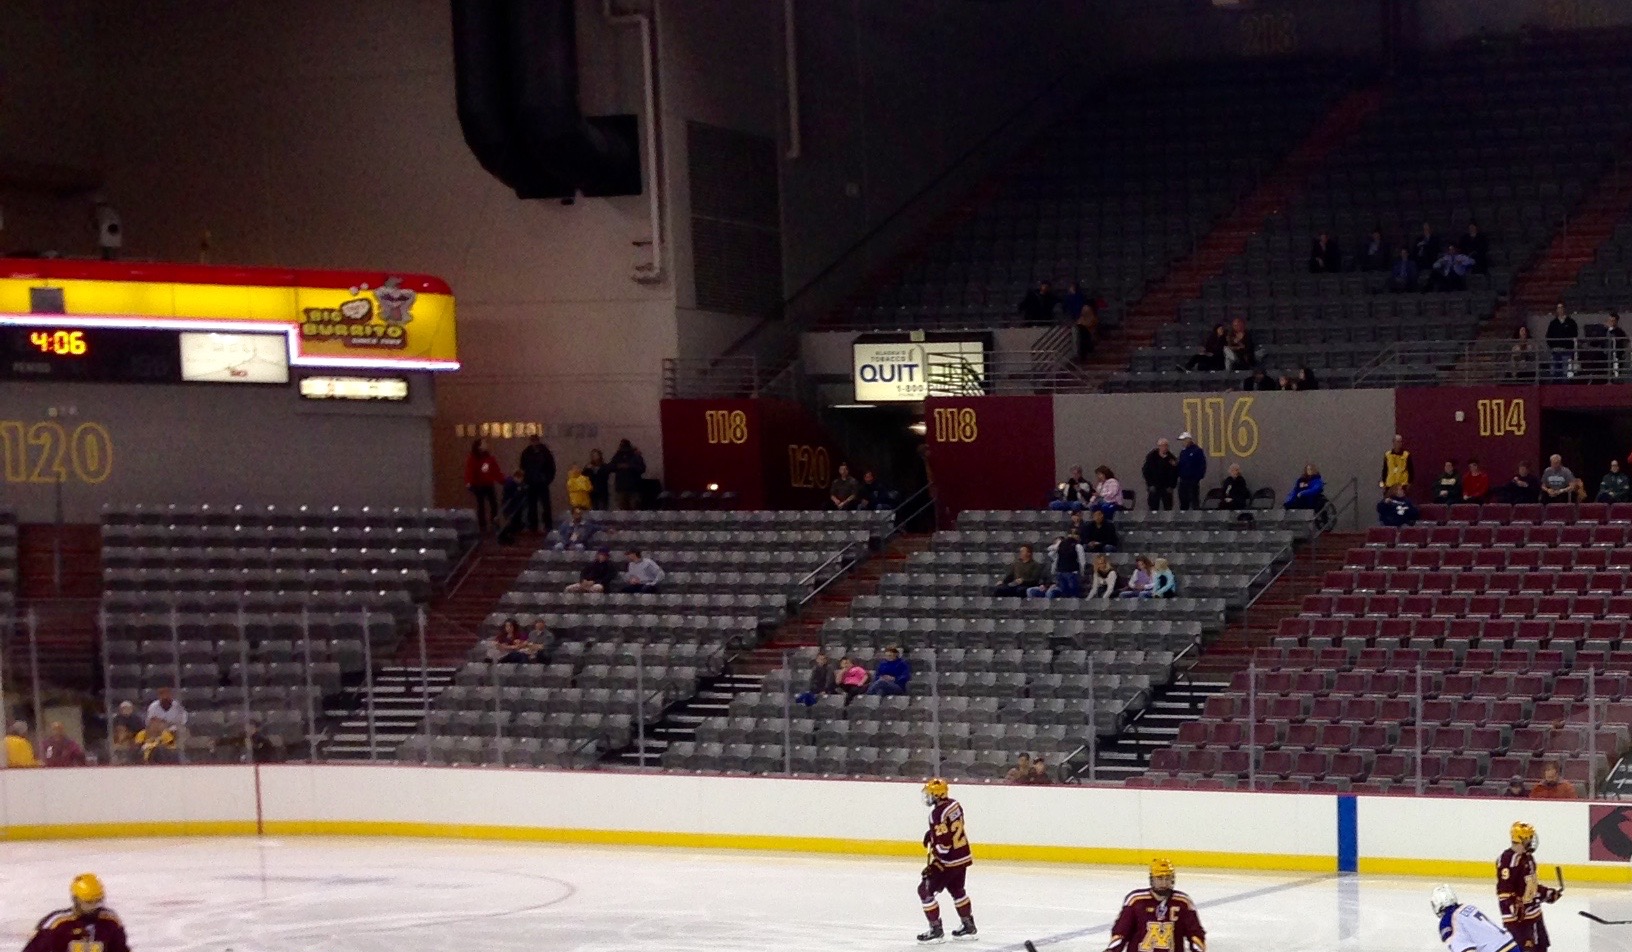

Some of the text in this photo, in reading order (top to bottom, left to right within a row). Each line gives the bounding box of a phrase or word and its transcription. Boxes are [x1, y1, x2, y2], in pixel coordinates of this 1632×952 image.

[303, 322, 403, 337] BURRITO
[309, 309, 343, 323] BIG
[30, 331, 87, 355] 4:06
[860, 363, 919, 383] QUIT
[705, 410, 748, 444] 118
[934, 407, 978, 443] 118
[1183, 396, 1260, 458] 116
[1477, 398, 1527, 437] 114
[0, 421, 113, 485] 120
[788, 444, 830, 489] 120
[1501, 867, 1510, 880] 9
[1169, 905, 1181, 922] C
